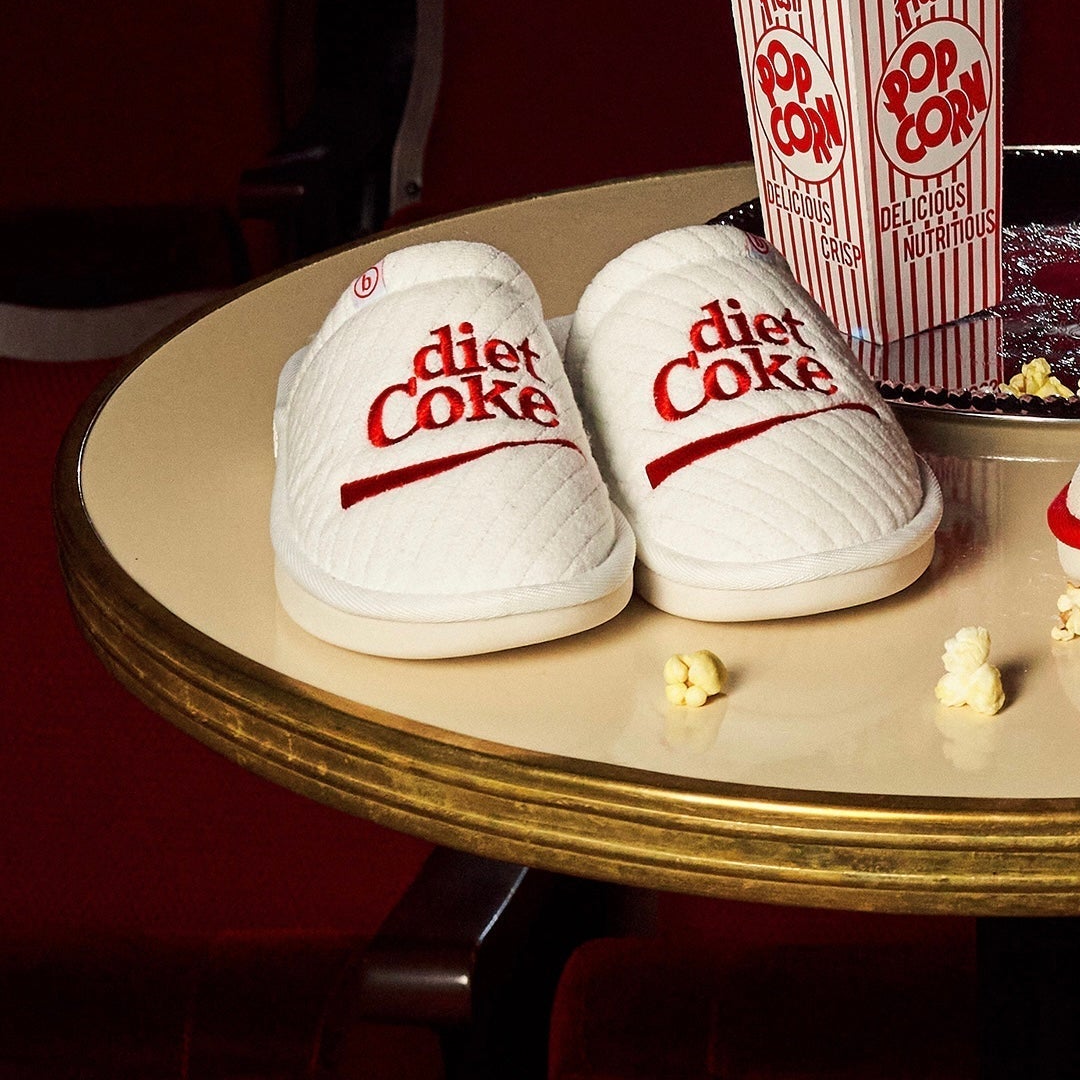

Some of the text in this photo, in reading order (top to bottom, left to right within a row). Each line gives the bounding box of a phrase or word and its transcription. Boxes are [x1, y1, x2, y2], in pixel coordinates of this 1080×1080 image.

[756, 39, 812, 108] POP
[882, 39, 958, 123] POP
[770, 94, 843, 164] CORN
[896, 60, 988, 164] CORN
[767, 180, 831, 226] DELICIOUS
[881, 182, 966, 233] DELICIOUS
[821, 235, 861, 268] CRISP
[903, 209, 996, 263] NUTRITIOUS
[413, 322, 546, 384] diet
[690, 298, 815, 354] diet
[367, 374, 560, 448] Coke
[653, 348, 838, 422] Coke
